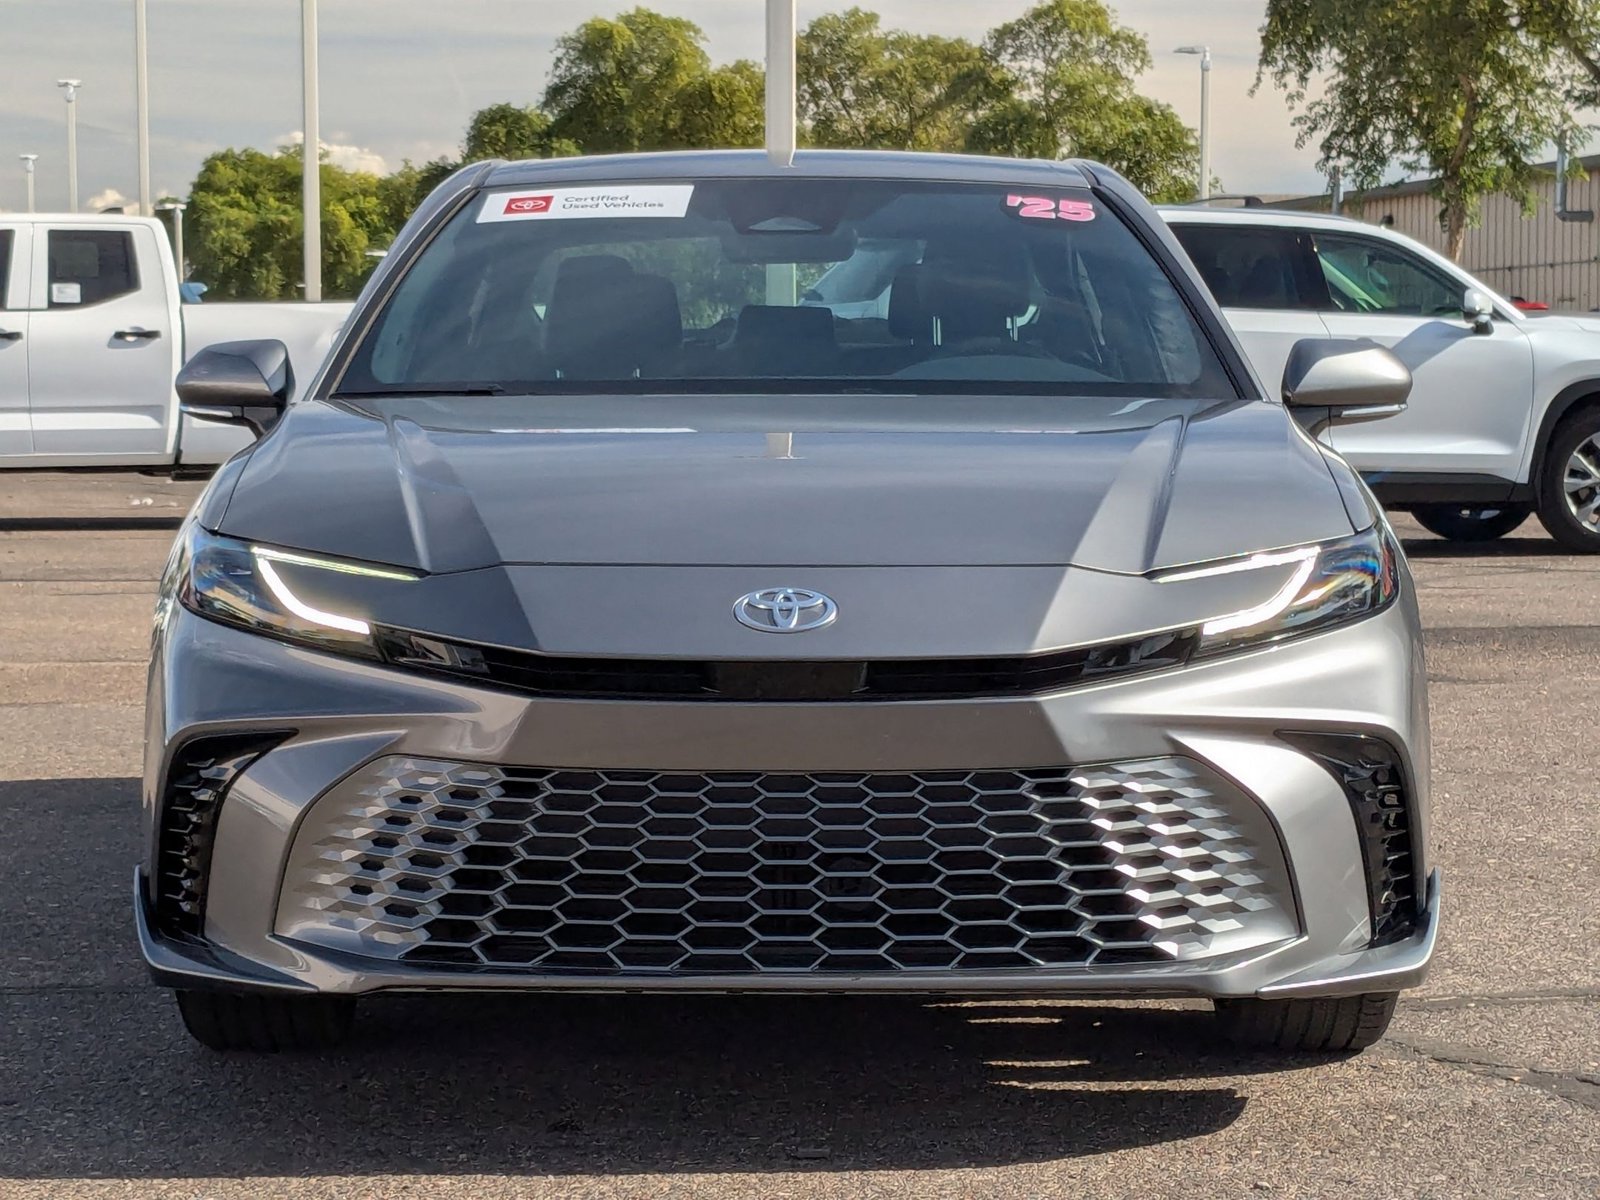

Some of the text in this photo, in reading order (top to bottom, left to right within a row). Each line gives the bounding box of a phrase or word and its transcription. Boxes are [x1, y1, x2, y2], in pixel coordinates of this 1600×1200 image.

[564, 194, 630, 203] Certified
[562, 201, 664, 210] Used Vehicles
[1006, 194, 1096, 222] '25
